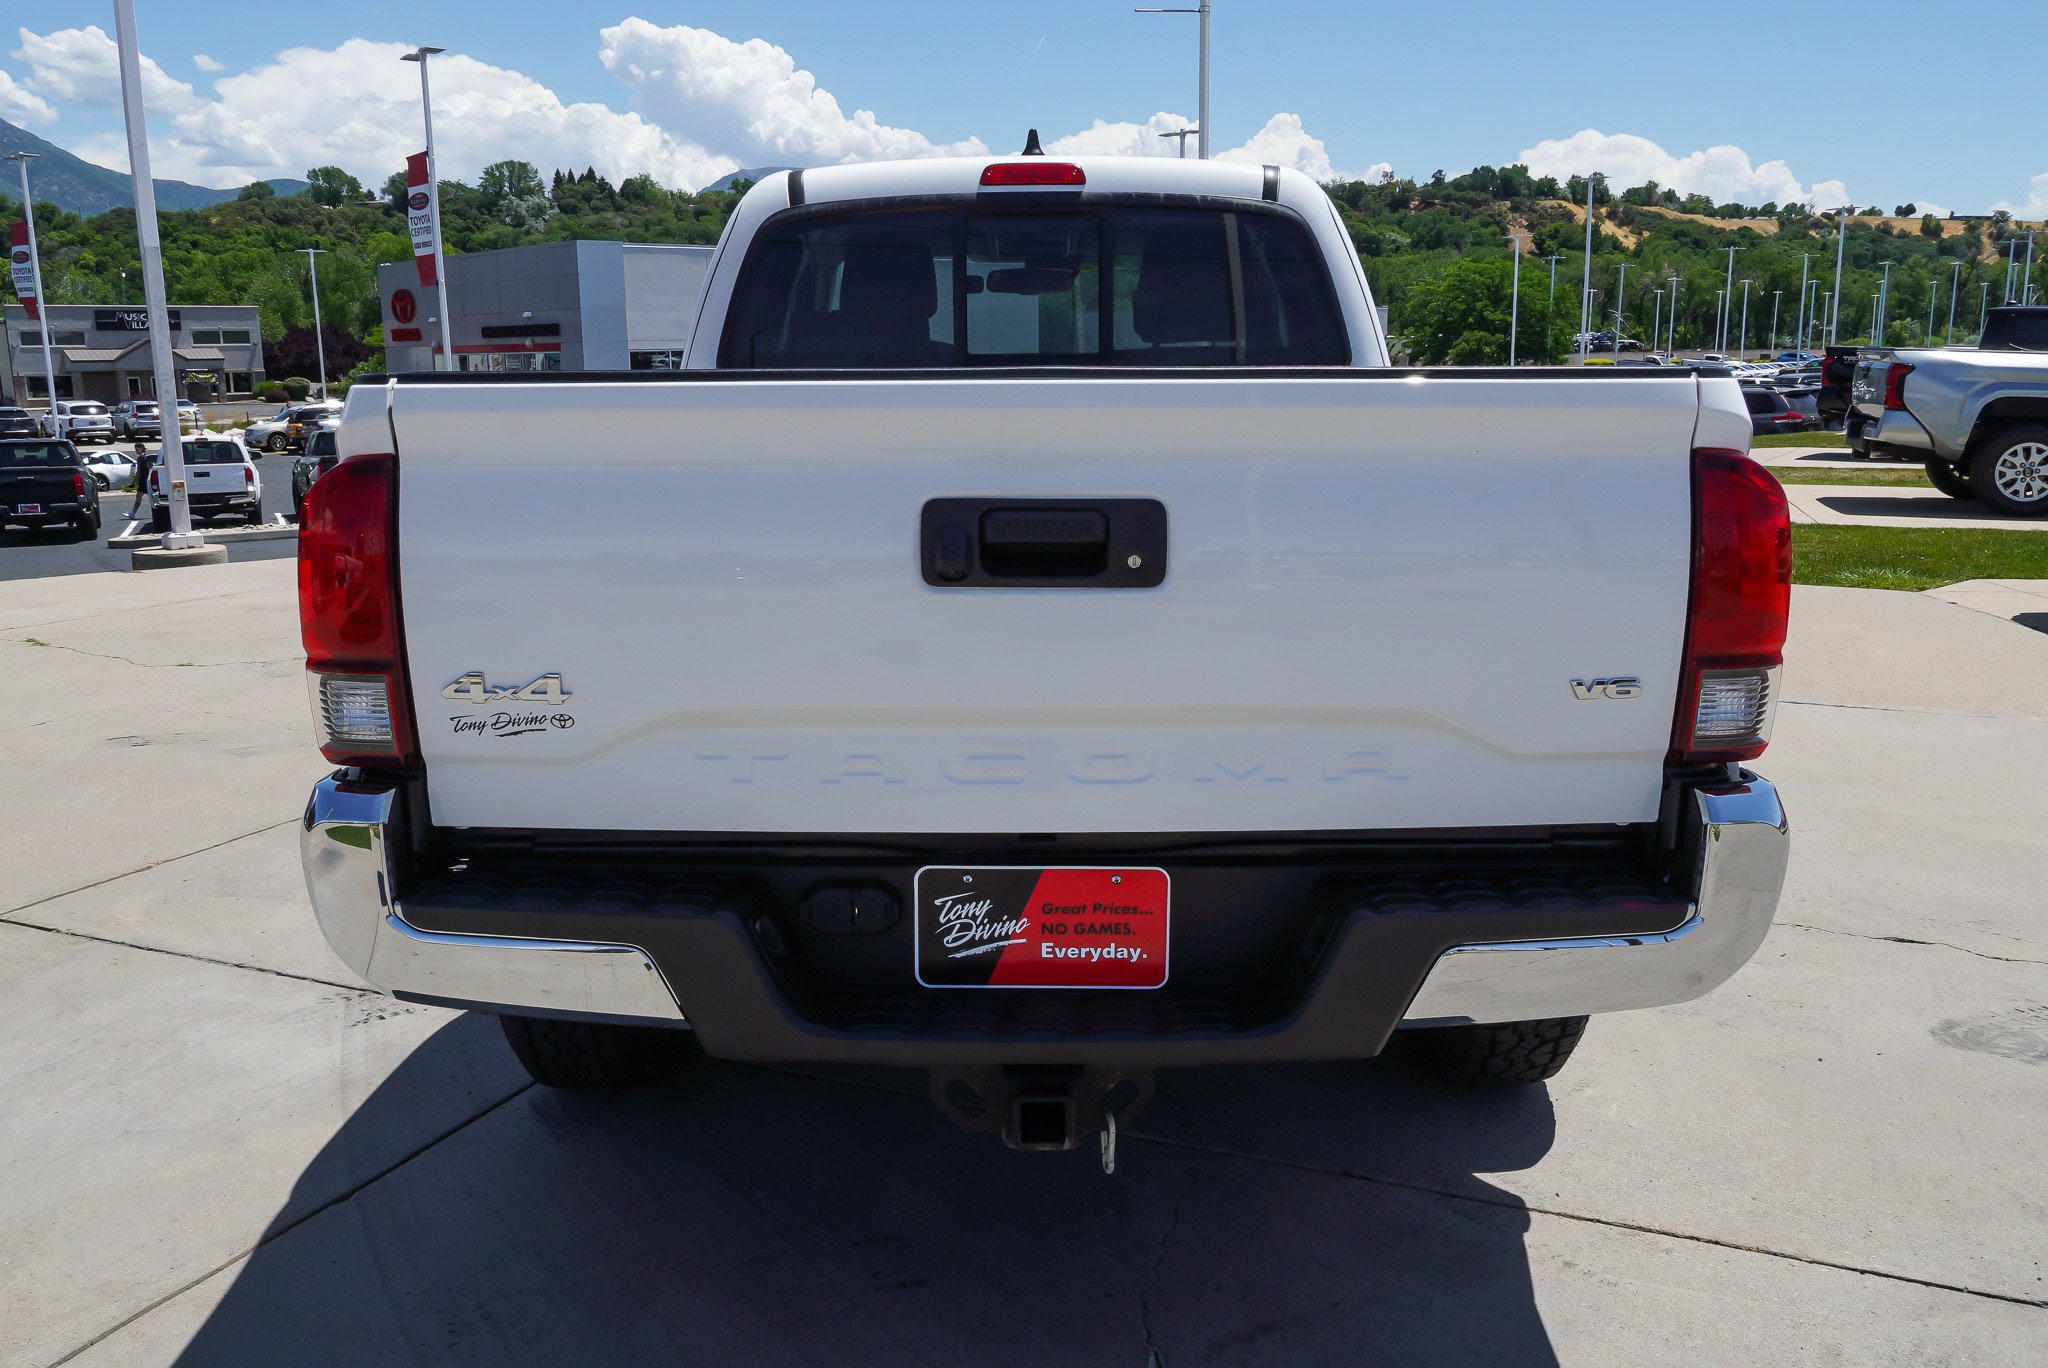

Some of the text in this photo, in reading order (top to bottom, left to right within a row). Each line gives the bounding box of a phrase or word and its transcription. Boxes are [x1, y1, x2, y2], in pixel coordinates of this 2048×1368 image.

[409, 213, 431, 227] TOYOTA
[410, 225, 432, 238] CERTIFIED
[12, 267, 31, 276] TOYOTA
[116, 311, 148, 322] MUSIC
[124, 319, 150, 330] VILLA
[995, 518, 1097, 539] TOYOTA
[441, 671, 573, 705] 4x4
[1570, 677, 1642, 701] V6
[450, 711, 548, 736] Tony Divino
[690, 744, 1408, 785] TACOMA
[934, 891, 994, 925] Tony
[1041, 902, 1154, 915] Great Prices...
[934, 914, 1032, 948] Divino
[1041, 922, 1137, 936] NO GAMES.
[1041, 942, 1148, 963] Everyday.
